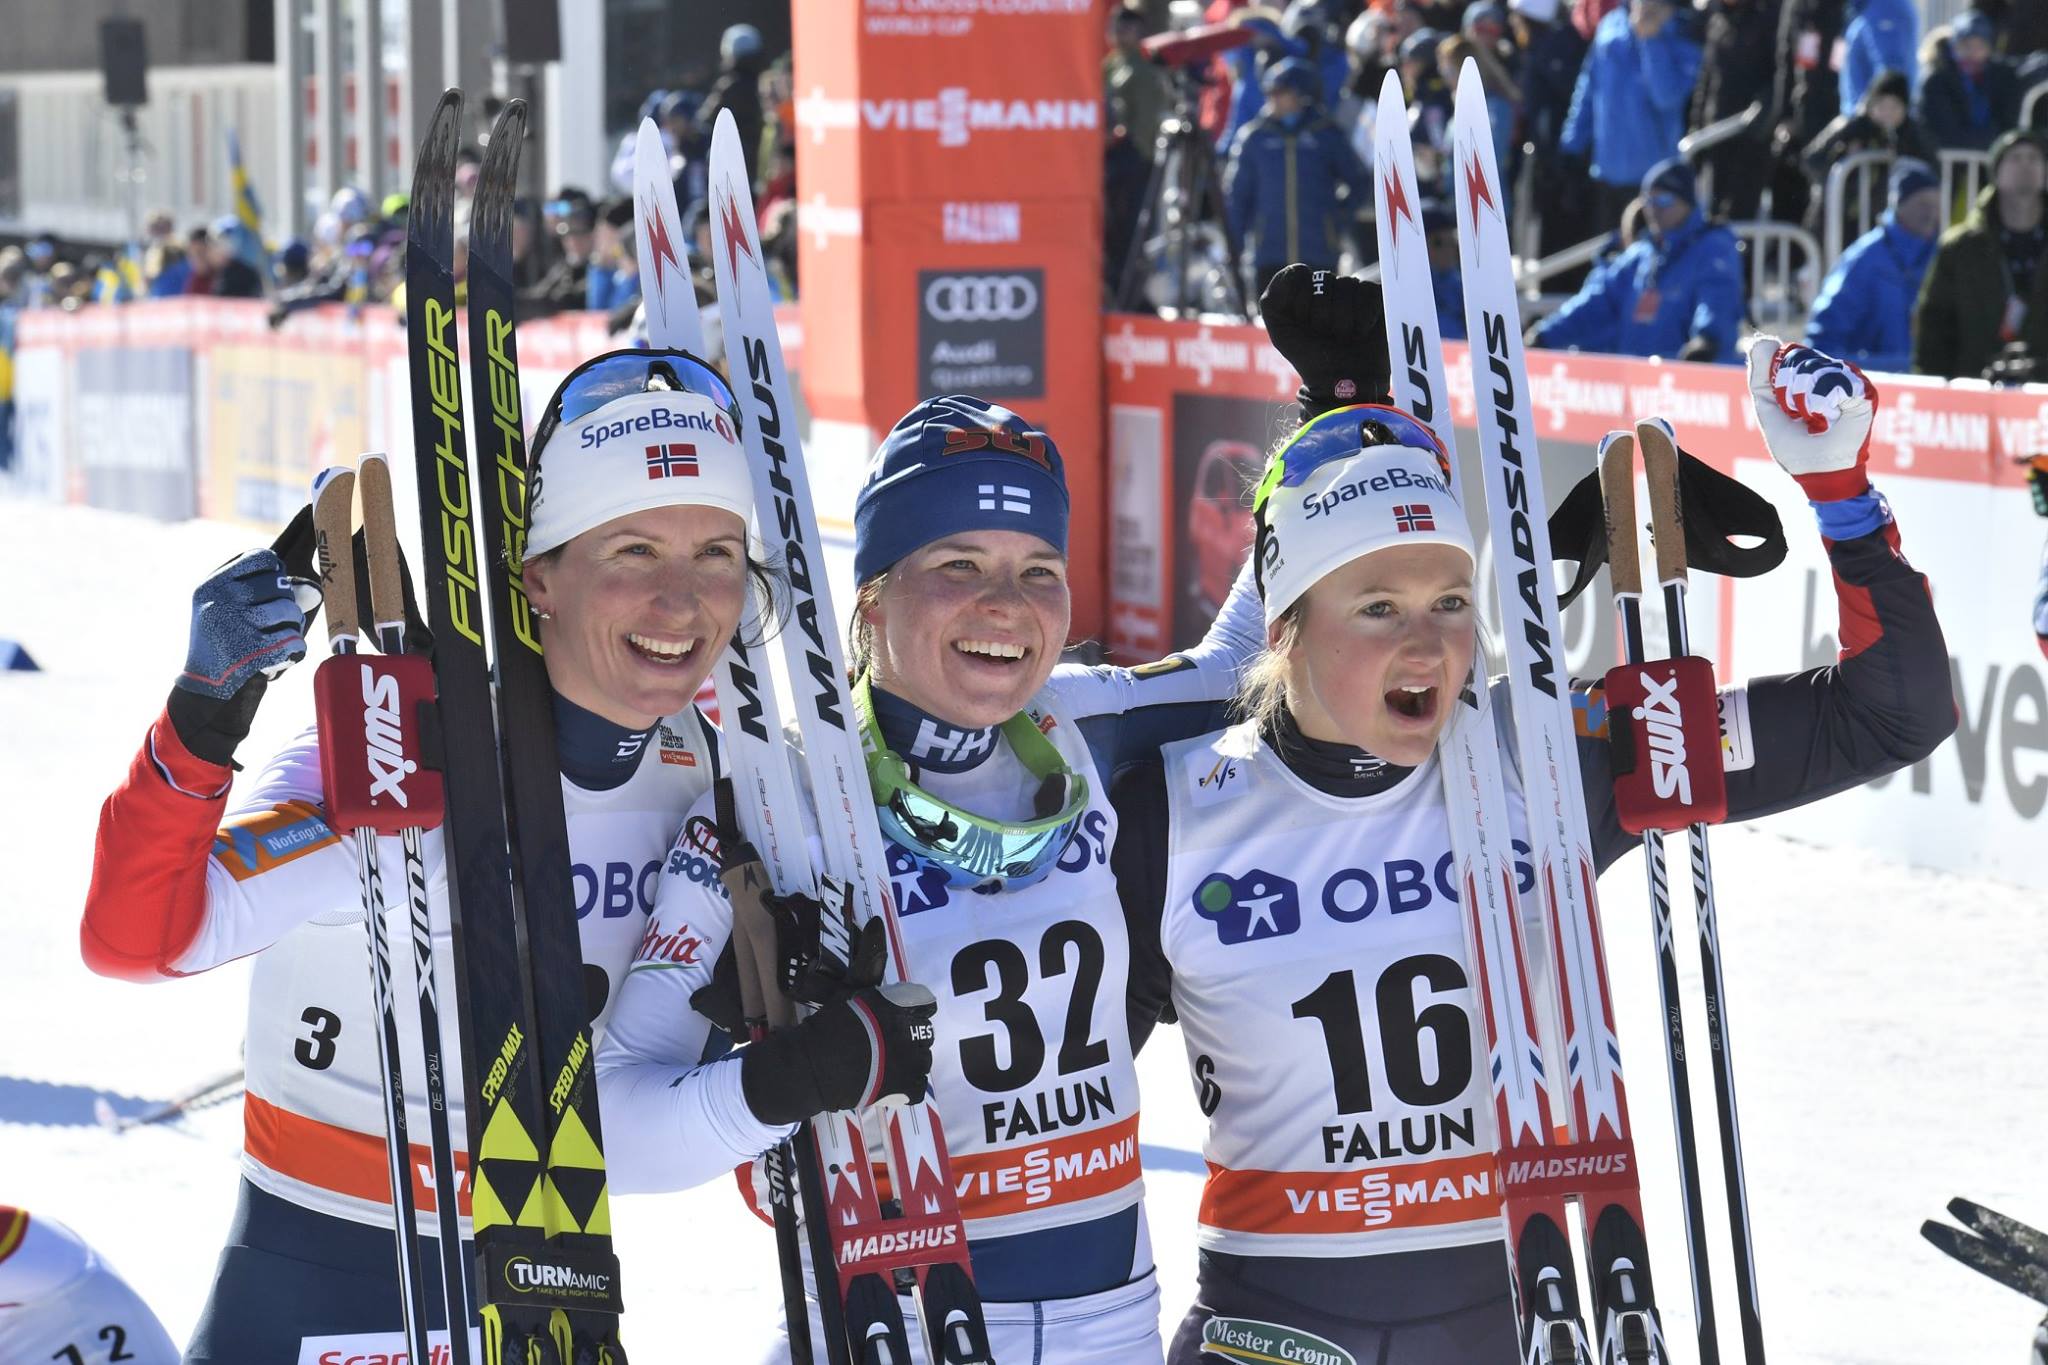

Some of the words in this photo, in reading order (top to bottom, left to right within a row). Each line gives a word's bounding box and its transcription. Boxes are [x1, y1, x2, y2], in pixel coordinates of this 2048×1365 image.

[863, 87, 1098, 146] VIESSMANN
[932, 341, 996, 364] Audi
[581, 408, 716, 449] SpareBank
[425, 298, 481, 646] FISCHER
[486, 309, 543, 656] FISCHER
[1303, 468, 1448, 520] SpareBank
[743, 336, 846, 732] MADSHUS
[1483, 311, 1558, 700] MADSHUS
[668, 850, 730, 900] SPOR
[853, 853, 874, 919] EDLINE
[951, 919, 1110, 1093] 32
[1291, 953, 1472, 1116] 16
[294, 1006, 342, 1071] 3
[481, 1056, 508, 1107] SPEED
[501, 1021, 524, 1066] MAX
[429, 1053, 441, 1092] TRAC
[550, 1065, 575, 1114] SPEED
[567, 1030, 590, 1074] MAX
[431, 1093, 443, 1111] 30
[982, 1076, 1116, 1144] FALUN
[1322, 1108, 1475, 1163] FALUN
[956, 1133, 1134, 1205] VIESSMANN
[1507, 1153, 1627, 1185] MADSHUS
[1285, 1172, 1502, 1227] VIESSMAN
[840, 1224, 957, 1265] MADSHUS
[513, 1262, 609, 1291] TURNAMIC
[536, 1287, 552, 1296] TAKE
[554, 1288, 568, 1297] THE
[569, 1289, 588, 1298] RIGHT
[1212, 1320, 1274, 1354] Mester
[1279, 1338, 1343, 1365] Grønn
